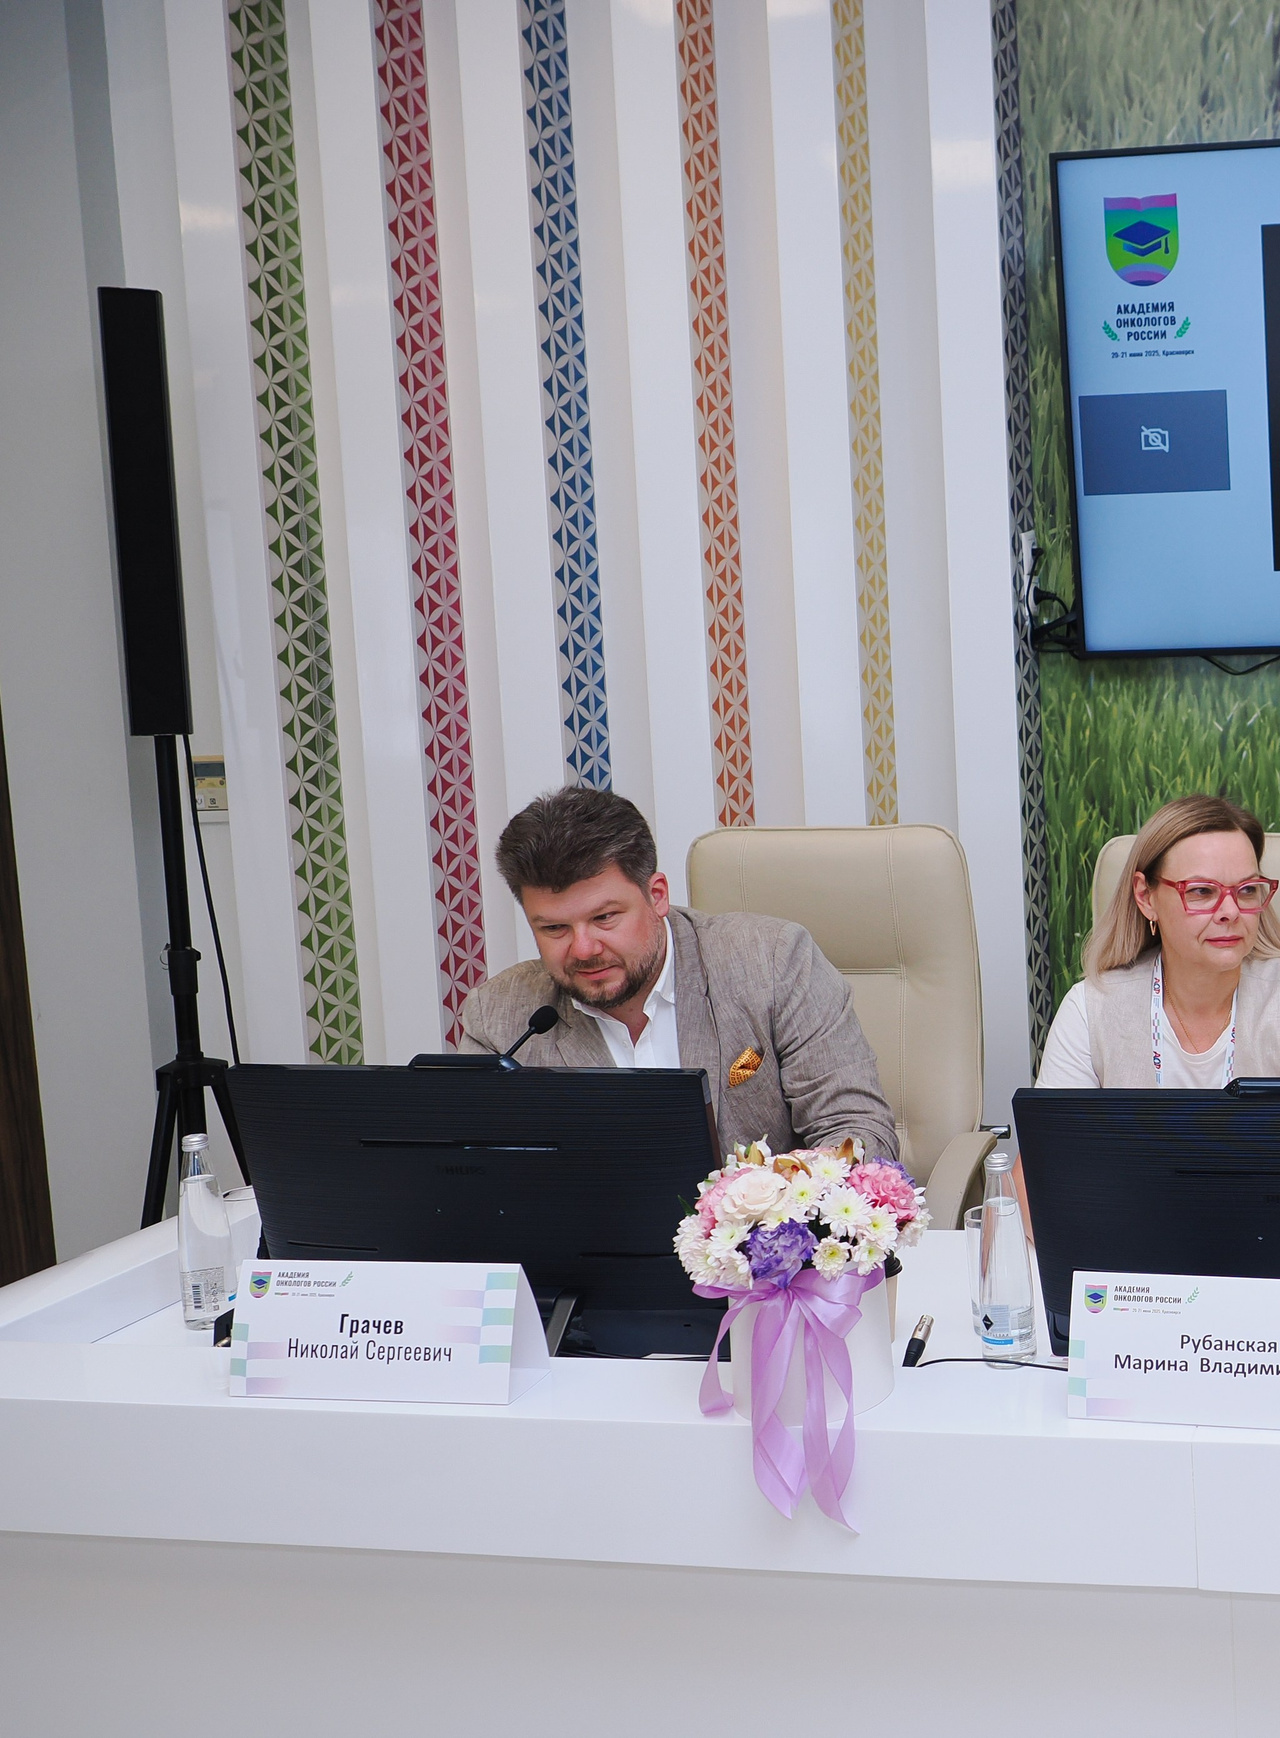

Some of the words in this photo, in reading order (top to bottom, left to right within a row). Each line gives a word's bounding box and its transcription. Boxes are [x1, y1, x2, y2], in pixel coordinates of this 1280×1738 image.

[1116, 301, 1175, 315] АКАДЕМИЯ
[1116, 315, 1176, 328] ОНКОЛОГОВ
[1127, 330, 1167, 341] РОССИИ
[339, 1313, 404, 1338] Грачев
[287, 1338, 359, 1360] Николай
[365, 1341, 453, 1364] Сергеевич
[1180, 1334, 1278, 1354] Рубанская
[1114, 1354, 1189, 1375] Марина
